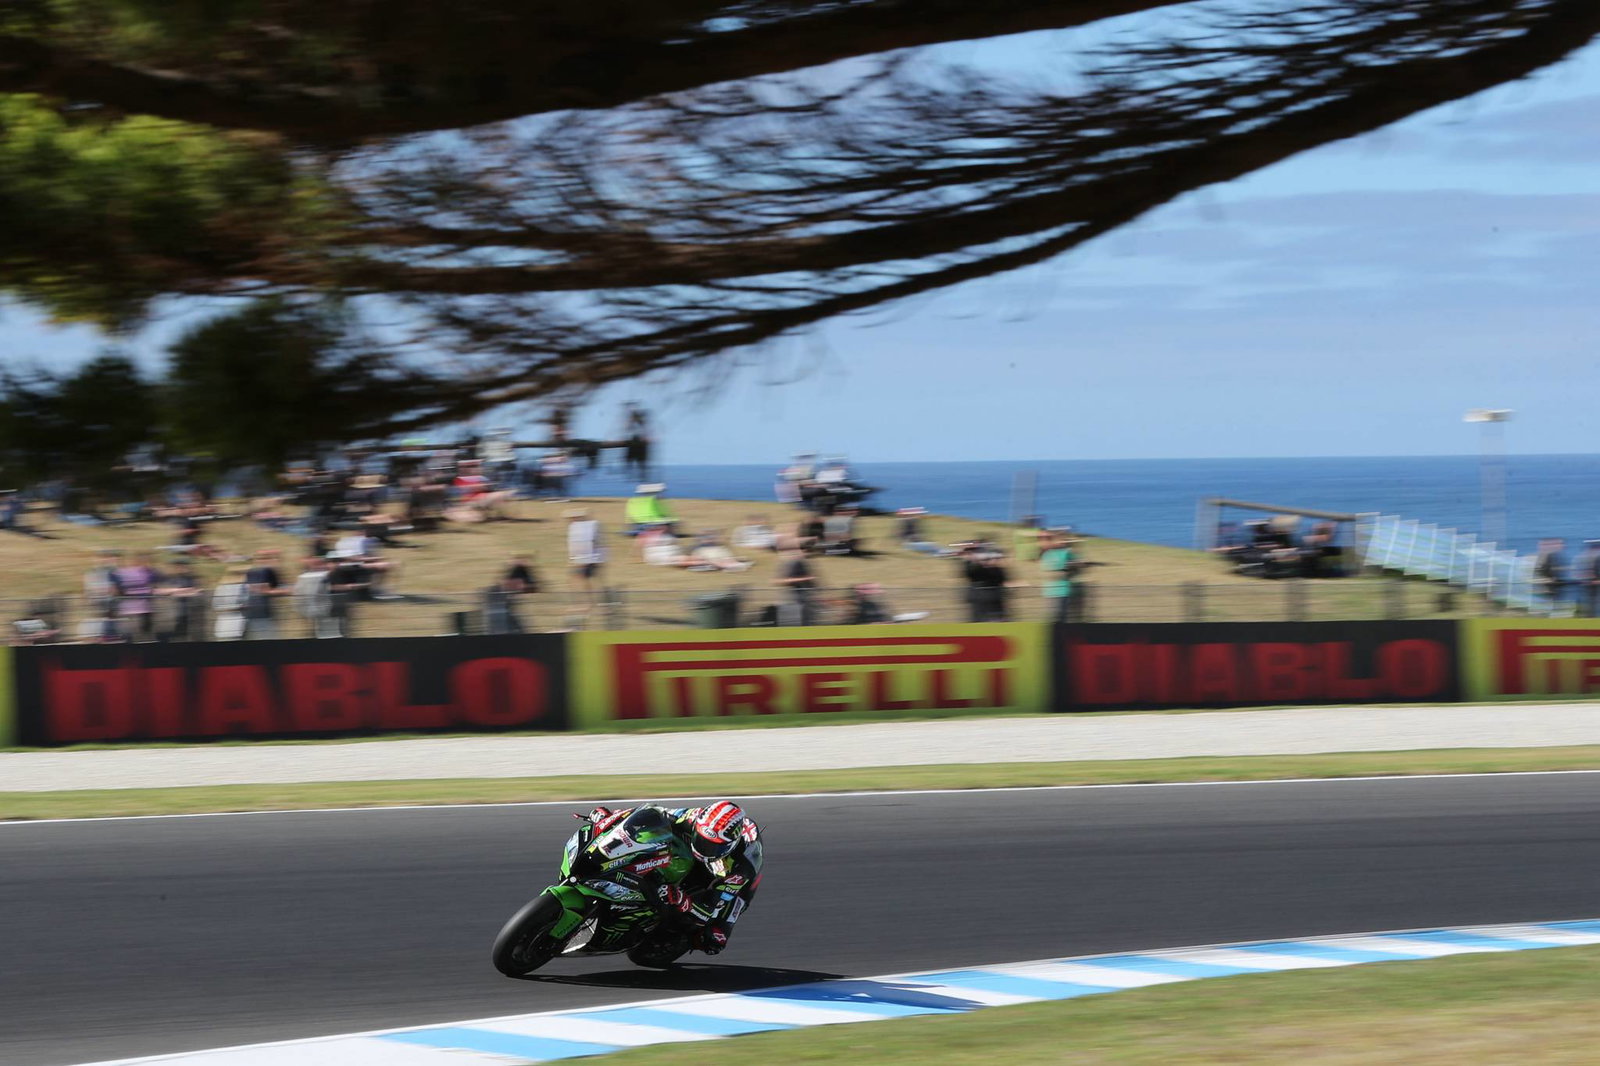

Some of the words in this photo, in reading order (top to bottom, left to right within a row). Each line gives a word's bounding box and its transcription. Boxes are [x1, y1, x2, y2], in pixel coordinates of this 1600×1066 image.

[46, 655, 549, 741] DIABLO
[607, 636, 1017, 719] PIRELLI
[1070, 637, 1448, 704] DIABLO
